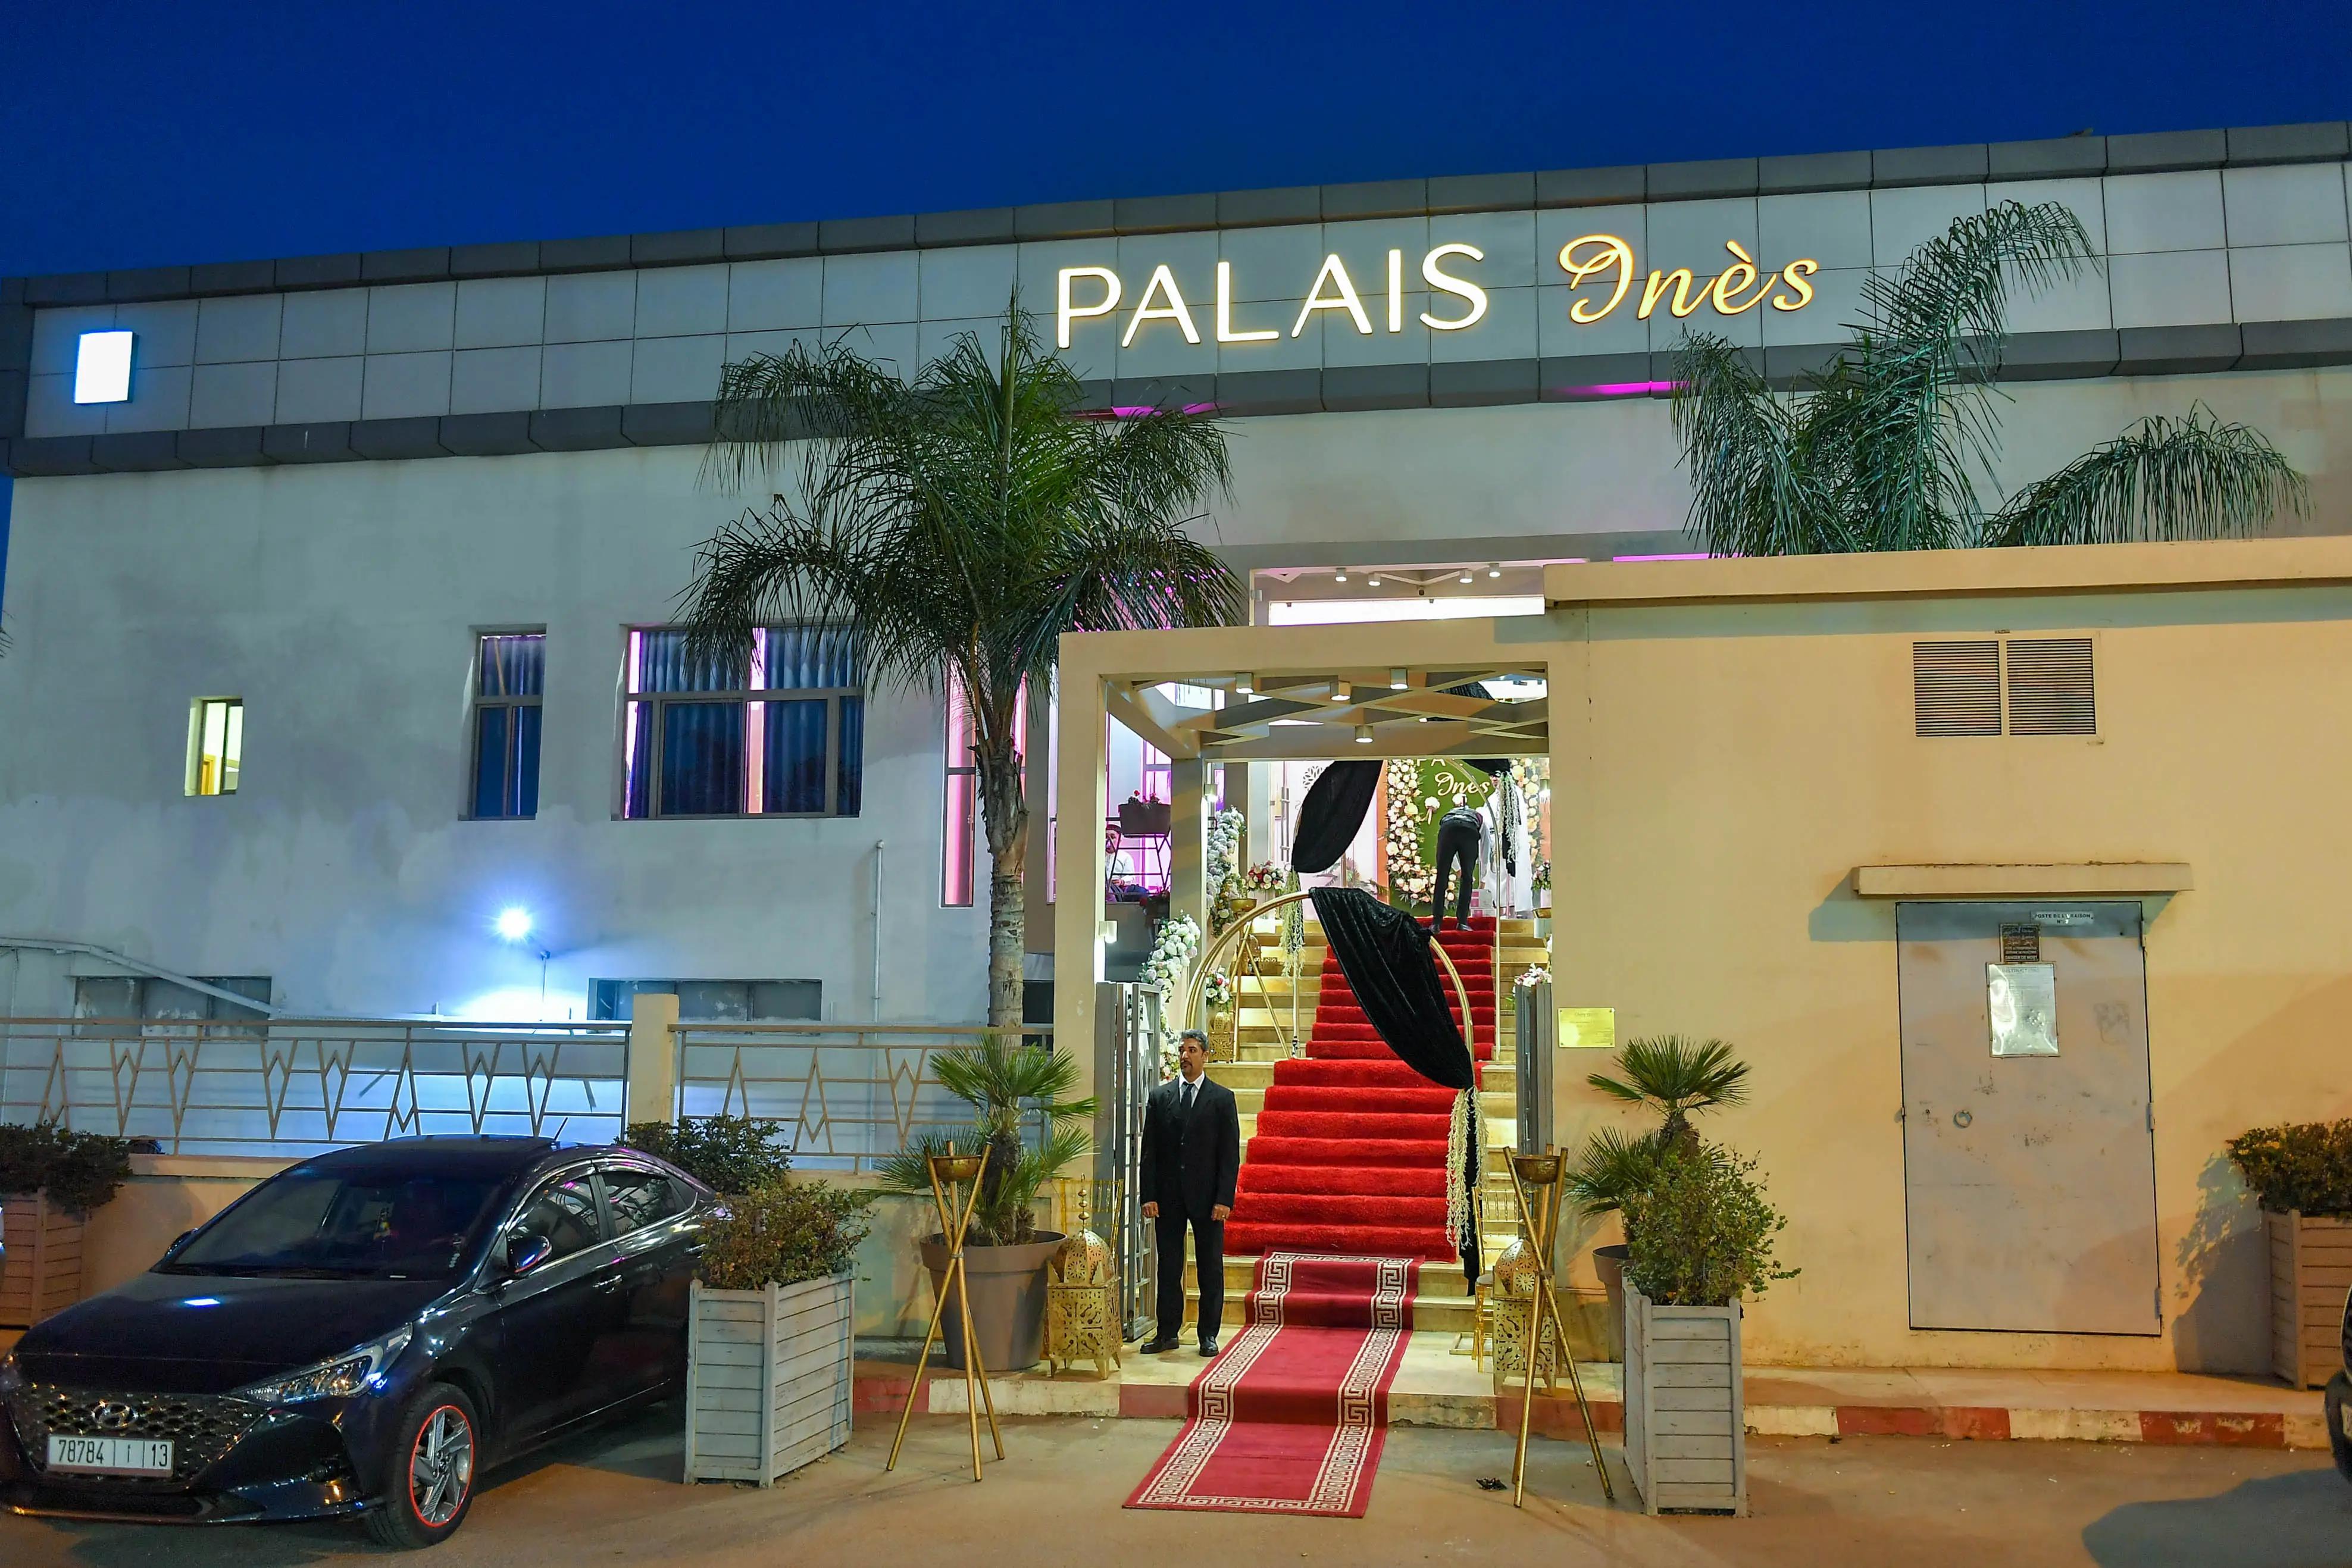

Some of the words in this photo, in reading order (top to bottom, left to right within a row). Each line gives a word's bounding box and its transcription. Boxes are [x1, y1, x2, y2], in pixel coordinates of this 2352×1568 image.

[1056, 243, 1489, 350] PALAIS
[1557, 233, 1819, 325] Inès
[59, 1439, 104, 1464] 78784
[152, 1444, 168, 1467] 13
